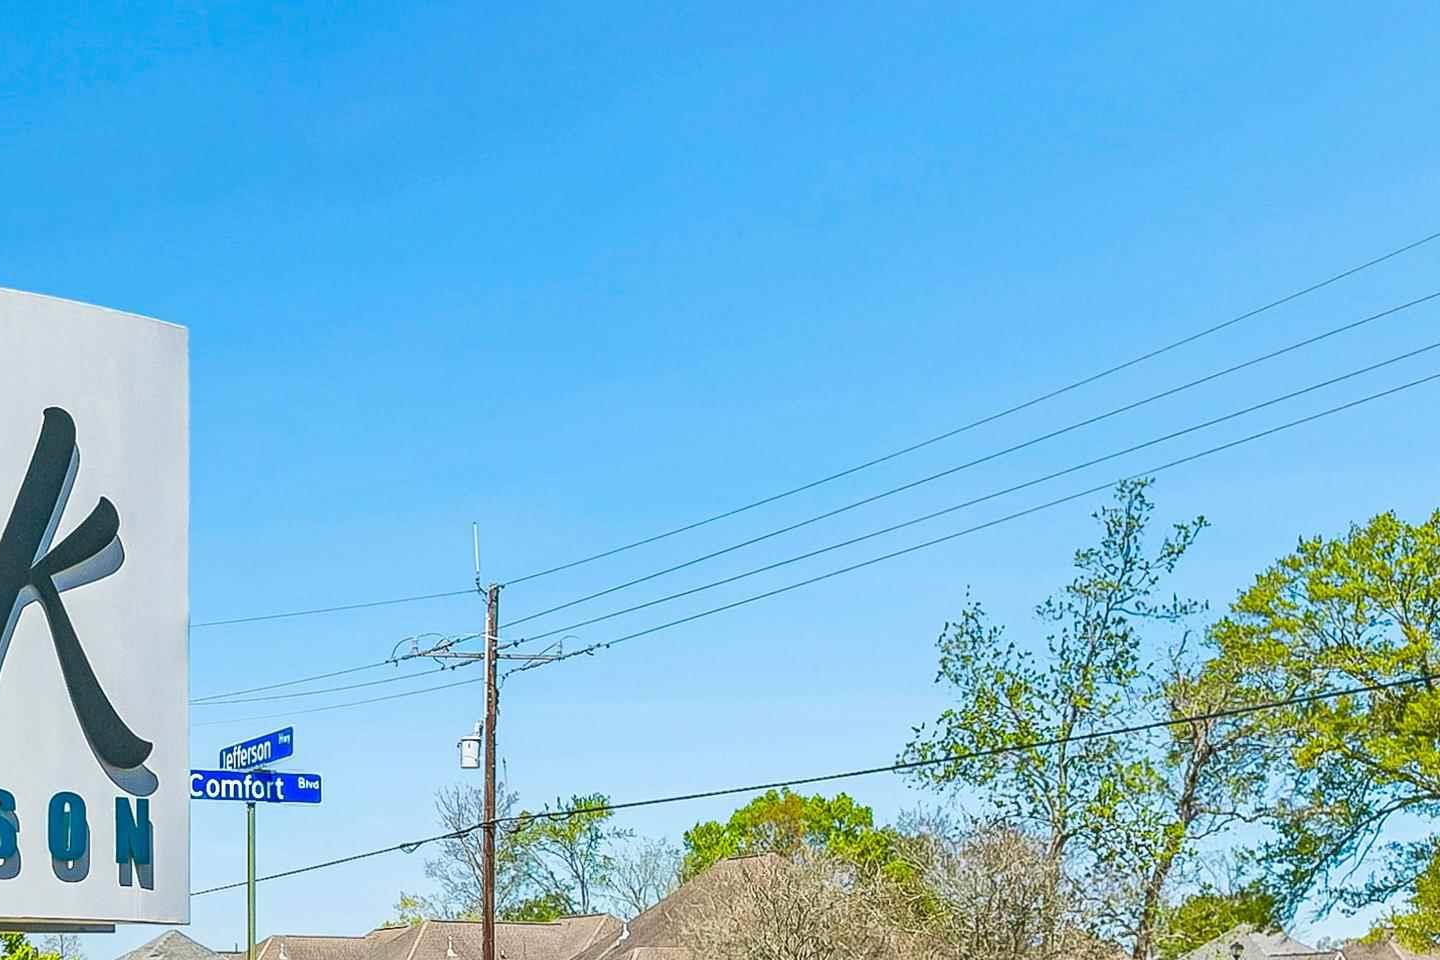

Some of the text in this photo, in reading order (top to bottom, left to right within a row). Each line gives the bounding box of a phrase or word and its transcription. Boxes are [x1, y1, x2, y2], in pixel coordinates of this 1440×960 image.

[222, 740, 272, 769] Jefferson
[190, 773, 320, 800] Comfort Blvd
